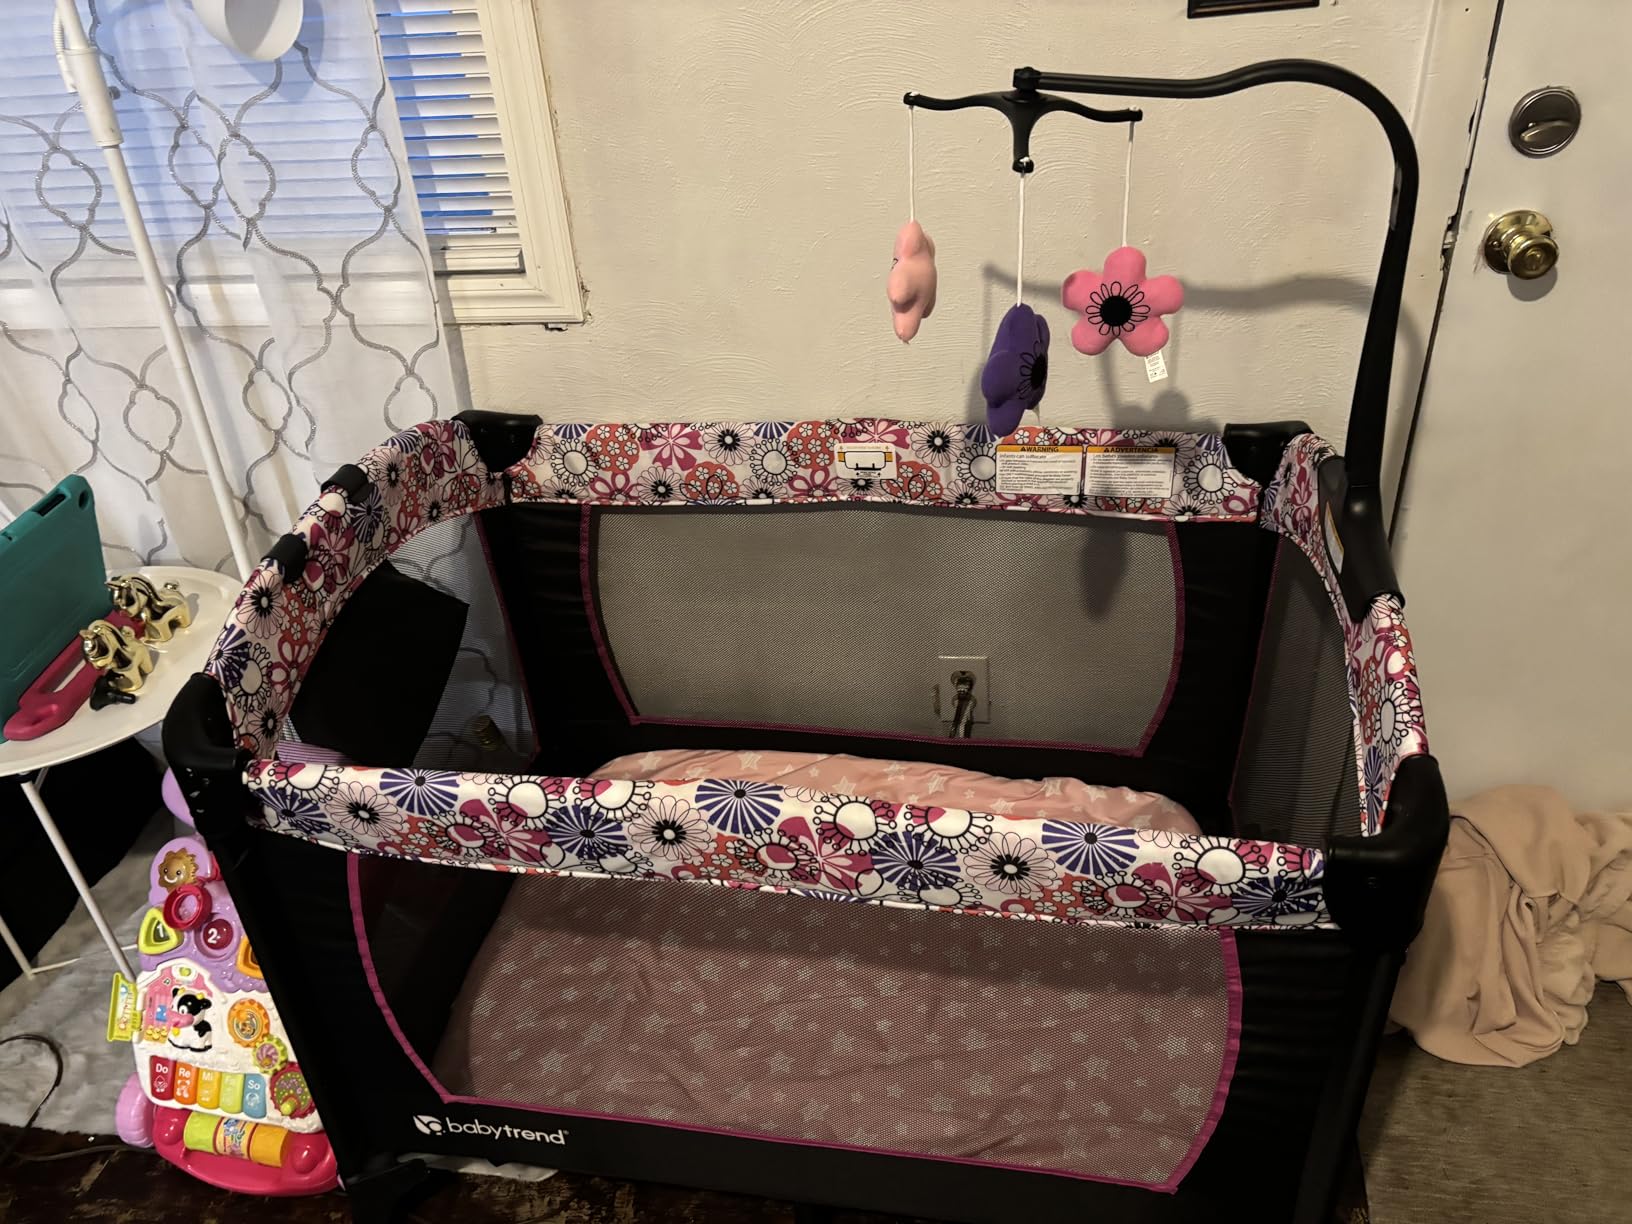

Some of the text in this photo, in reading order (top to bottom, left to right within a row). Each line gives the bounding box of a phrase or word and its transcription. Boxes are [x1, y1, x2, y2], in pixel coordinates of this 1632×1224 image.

[156, 923, 165, 938] 1
[207, 927, 219, 944] 2
[155, 1063, 169, 1074] Do
[178, 1067, 191, 1078] Re
[247, 1079, 261, 1090] So
